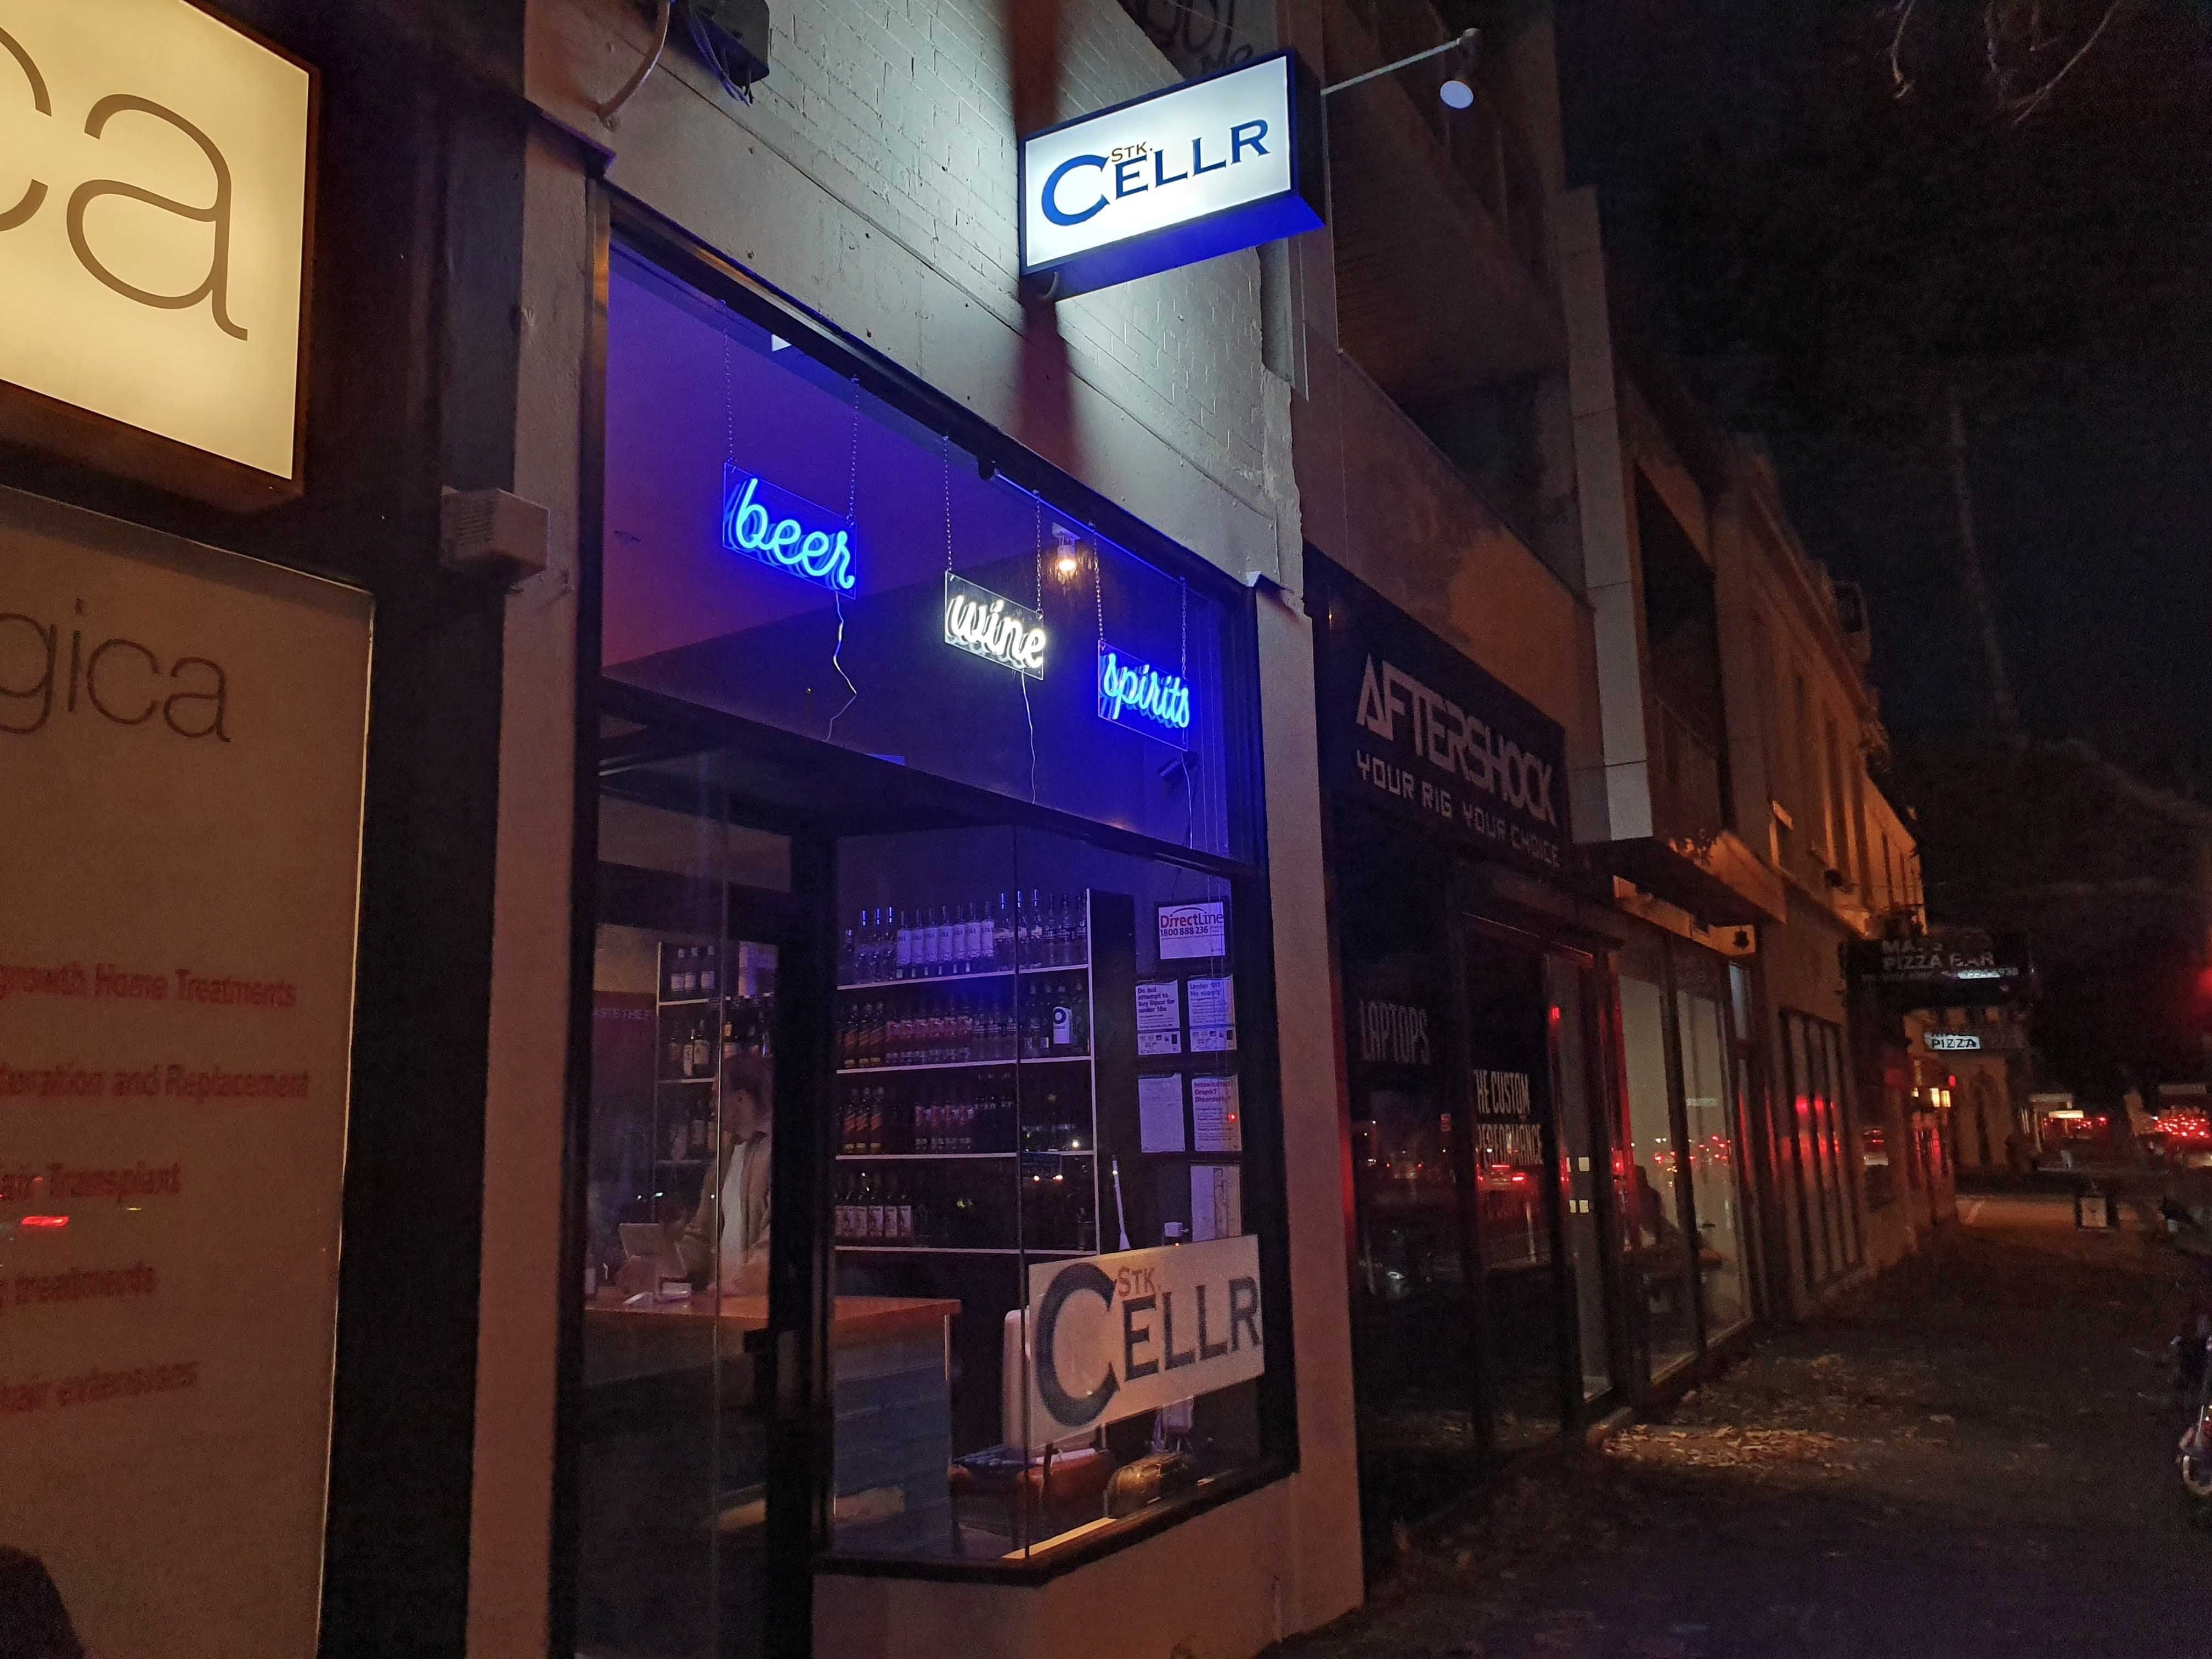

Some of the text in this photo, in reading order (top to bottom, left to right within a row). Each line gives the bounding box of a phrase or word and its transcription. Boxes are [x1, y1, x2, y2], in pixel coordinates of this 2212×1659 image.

[1041, 119, 1271, 226] CELLR
[736, 478, 855, 589] beer
[948, 595, 1046, 669] wine
[1103, 653, 1190, 728] spirits
[1356, 652, 1557, 827] AFTERSHOCK
[1356, 749, 1414, 799] YOUR
[1422, 780, 1453, 819] RIG
[1462, 800, 1506, 839] YOUR
[94, 963, 168, 1000] Home
[175, 969, 297, 1008] Treatments
[1883, 955, 1943, 970] PIZZA
[1932, 1039, 1977, 1048] PIZZA
[165, 1064, 309, 1104] Replacement
[1491, 1070, 1531, 1115] CUSTOM
[1035, 1262, 1261, 1427] CELLR
